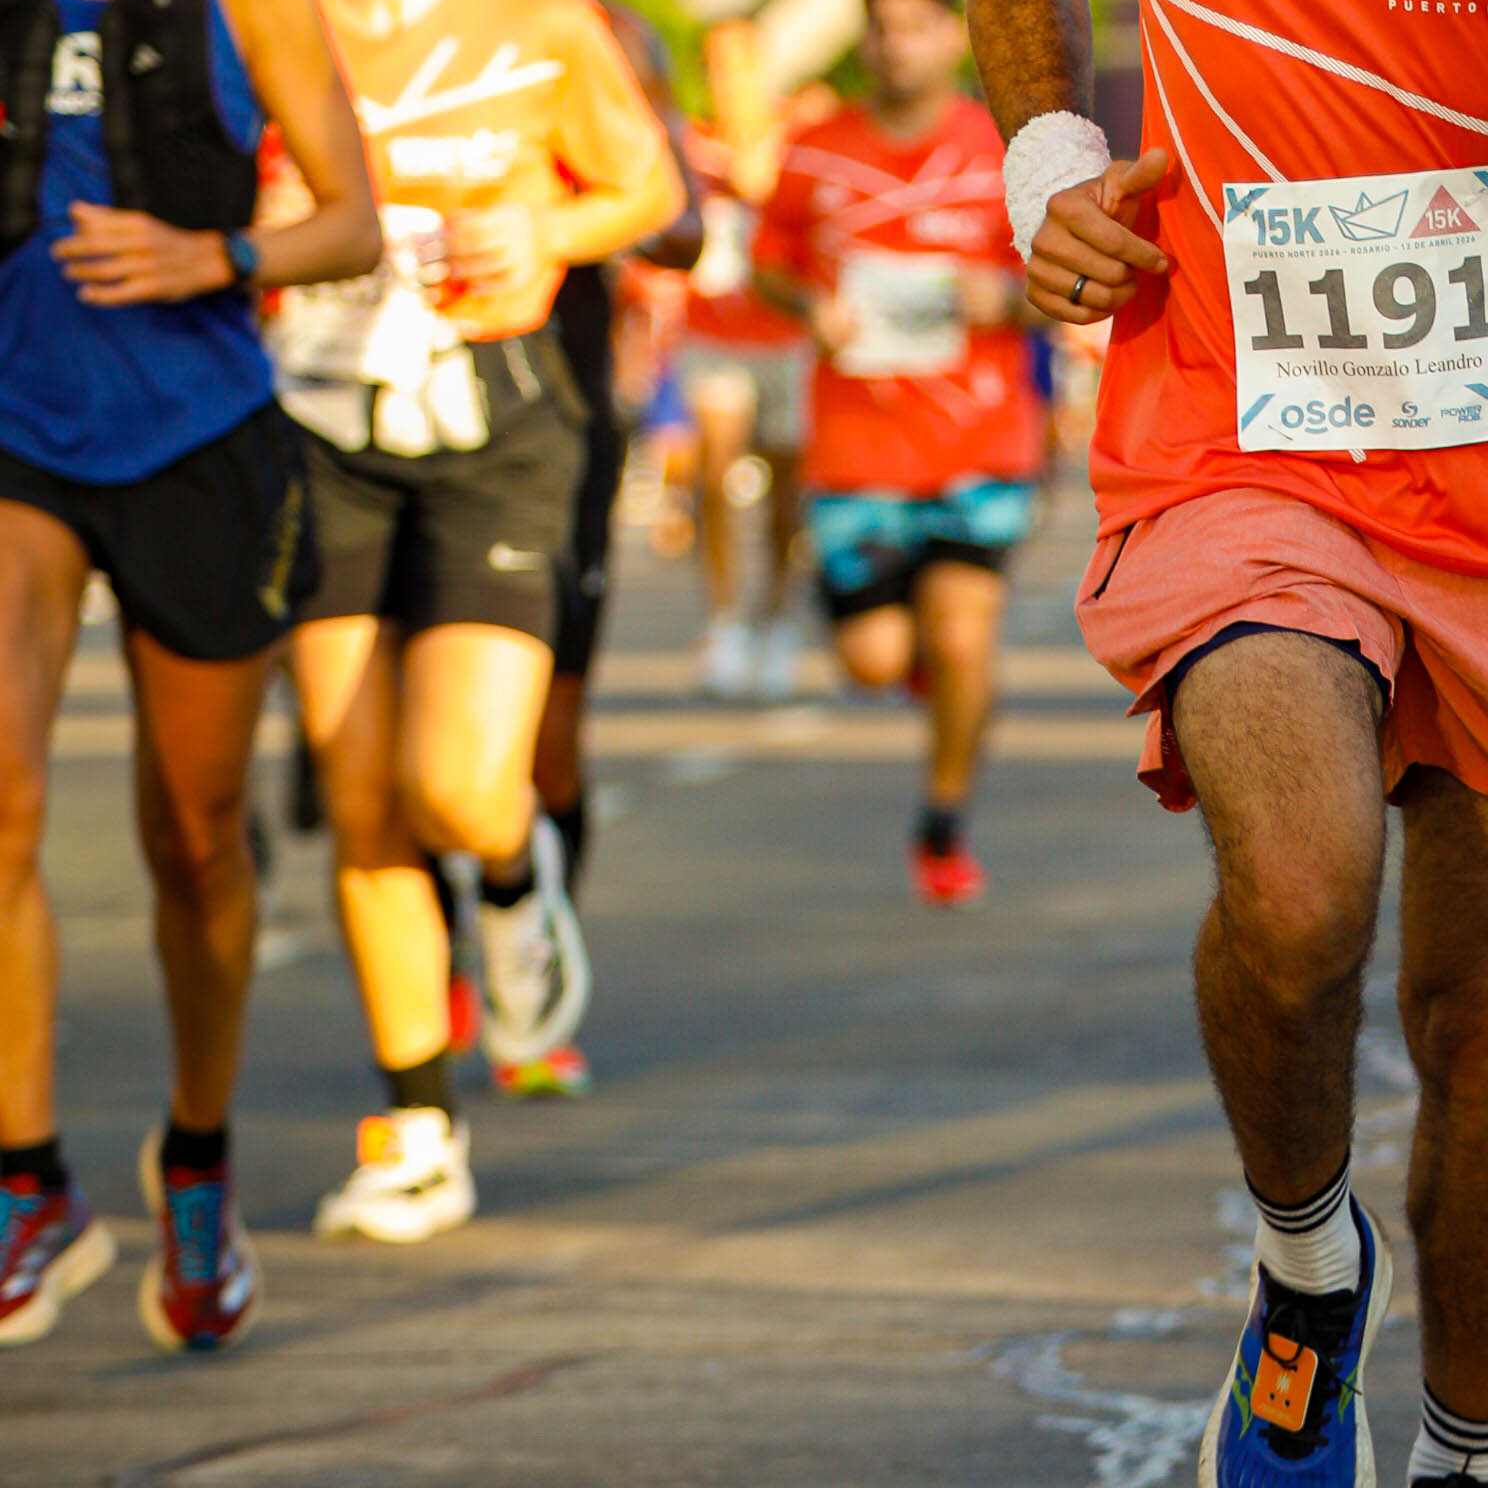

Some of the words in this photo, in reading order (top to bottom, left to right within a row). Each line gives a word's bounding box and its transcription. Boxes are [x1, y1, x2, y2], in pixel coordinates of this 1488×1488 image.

[1252, 207, 1325, 245] 15K
[1426, 207, 1462, 230] 15K
[1252, 250, 1285, 259] PUERTO
[1287, 249, 1315, 258] NORTE
[1350, 244, 1391, 255] ROSARIO
[1414, 240, 1425, 249] DE
[1429, 238, 1453, 248] ABRIL
[1276, 360, 1339, 379] Novillo
[1343, 361, 1410, 378] Gonzalo
[1415, 353, 1483, 375] Leandro
[1280, 395, 1376, 431] osde
